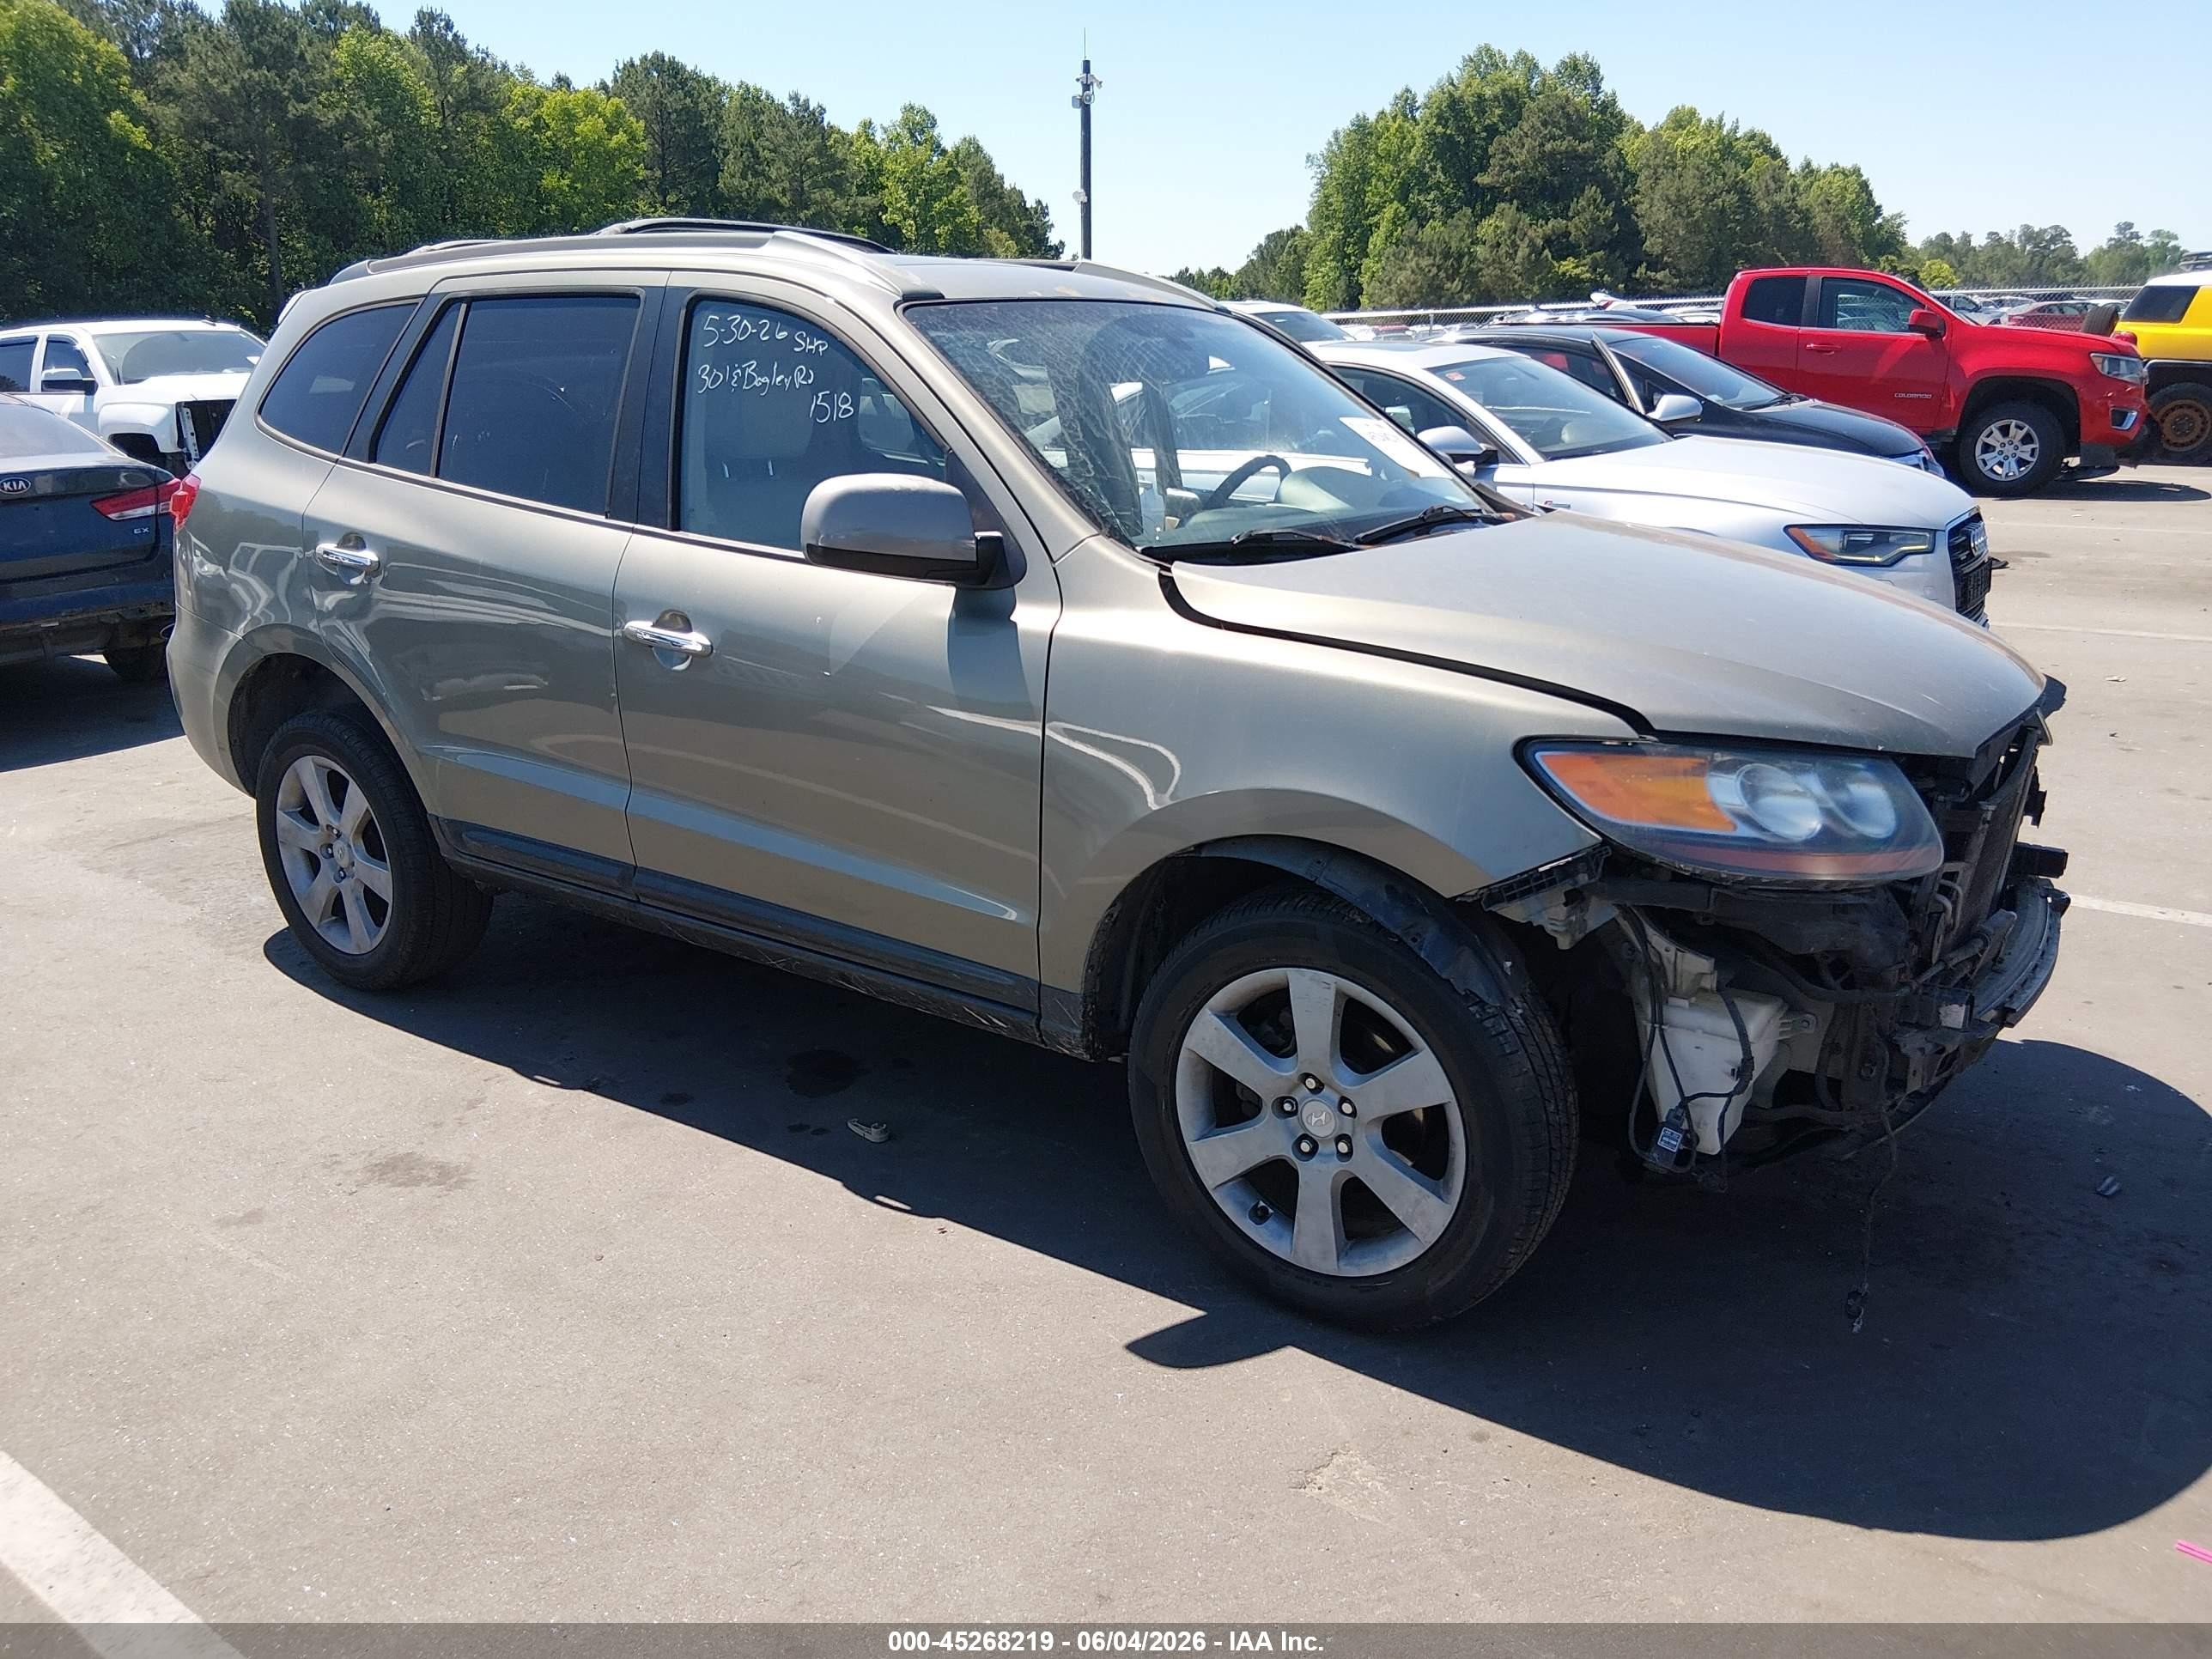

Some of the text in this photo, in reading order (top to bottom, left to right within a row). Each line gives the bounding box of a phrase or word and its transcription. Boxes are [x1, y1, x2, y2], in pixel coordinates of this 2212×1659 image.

[703, 314, 788, 347] 5-30-26
[809, 391, 854, 423] 1518
[3, 480, 27, 491] KIA
